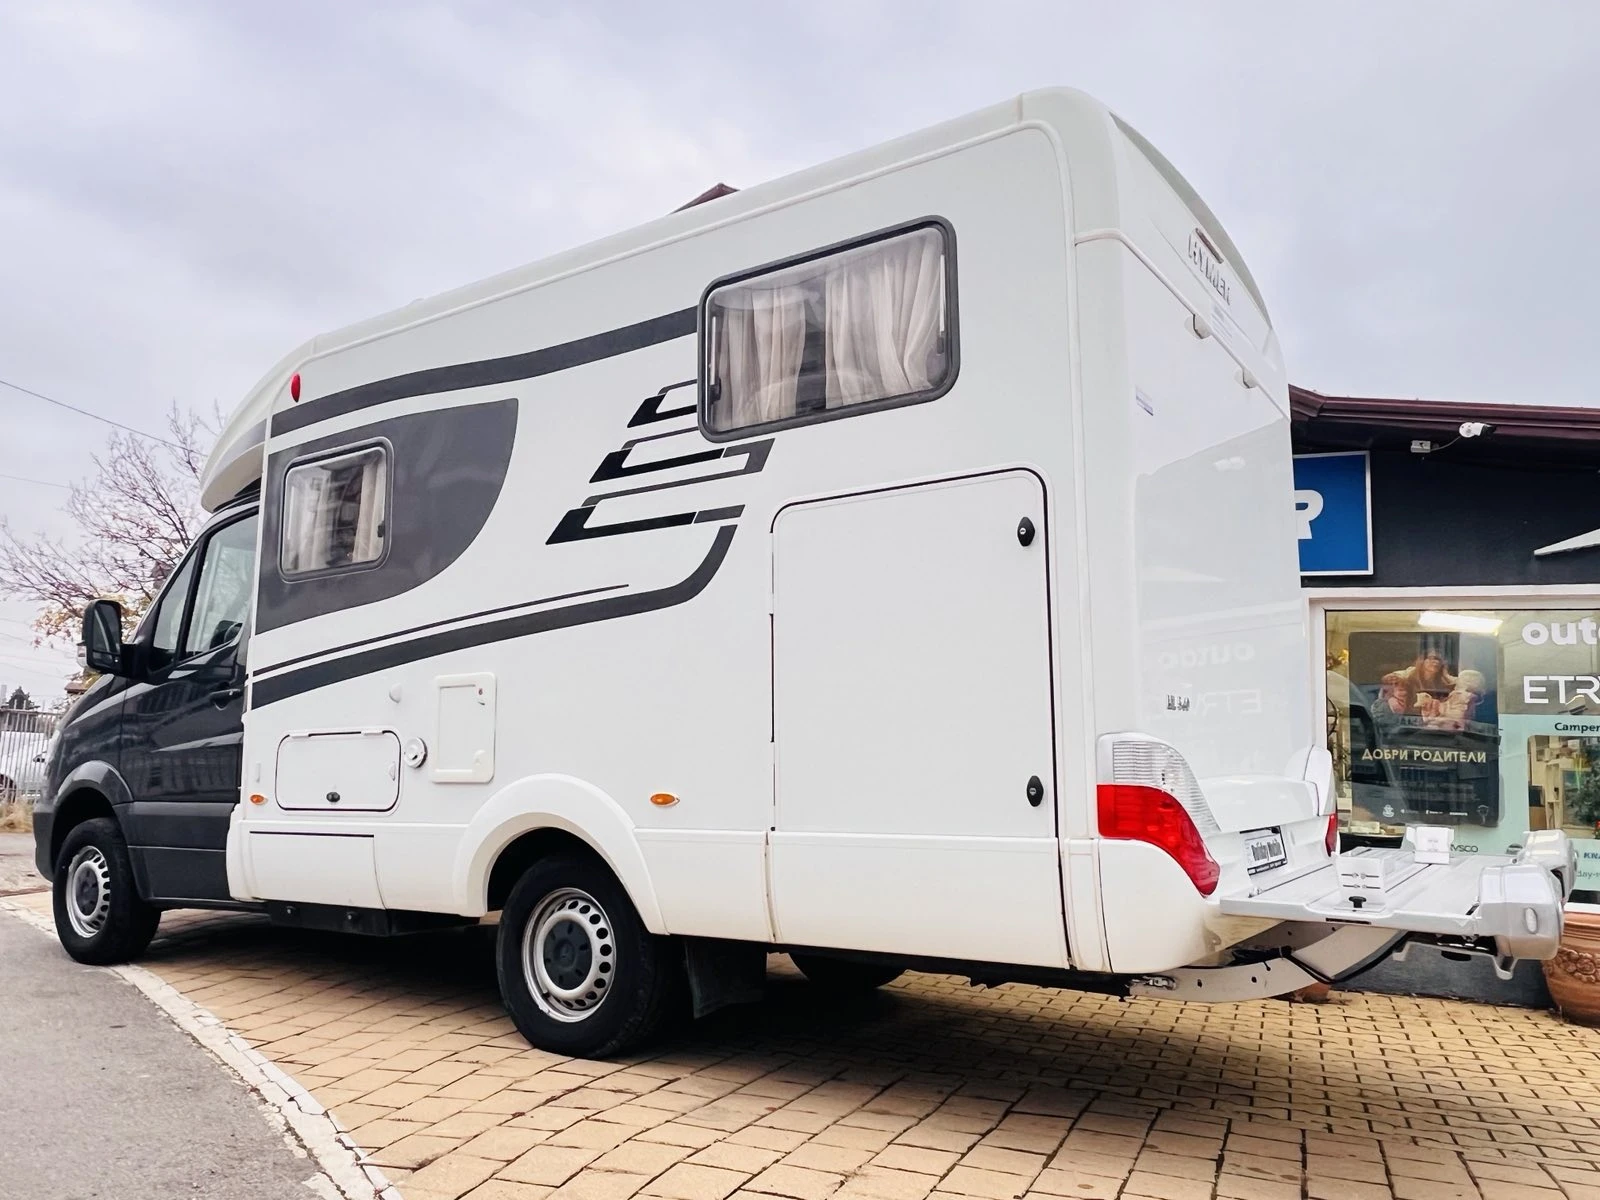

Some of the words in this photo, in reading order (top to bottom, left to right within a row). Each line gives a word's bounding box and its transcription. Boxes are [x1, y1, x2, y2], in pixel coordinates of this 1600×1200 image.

[1522, 618, 1600, 645] out
[1523, 675, 1600, 704] ETR
[1361, 748, 1408, 761] ДОБРИ
[1413, 750, 1487, 763] РОДИТЕЛИ
